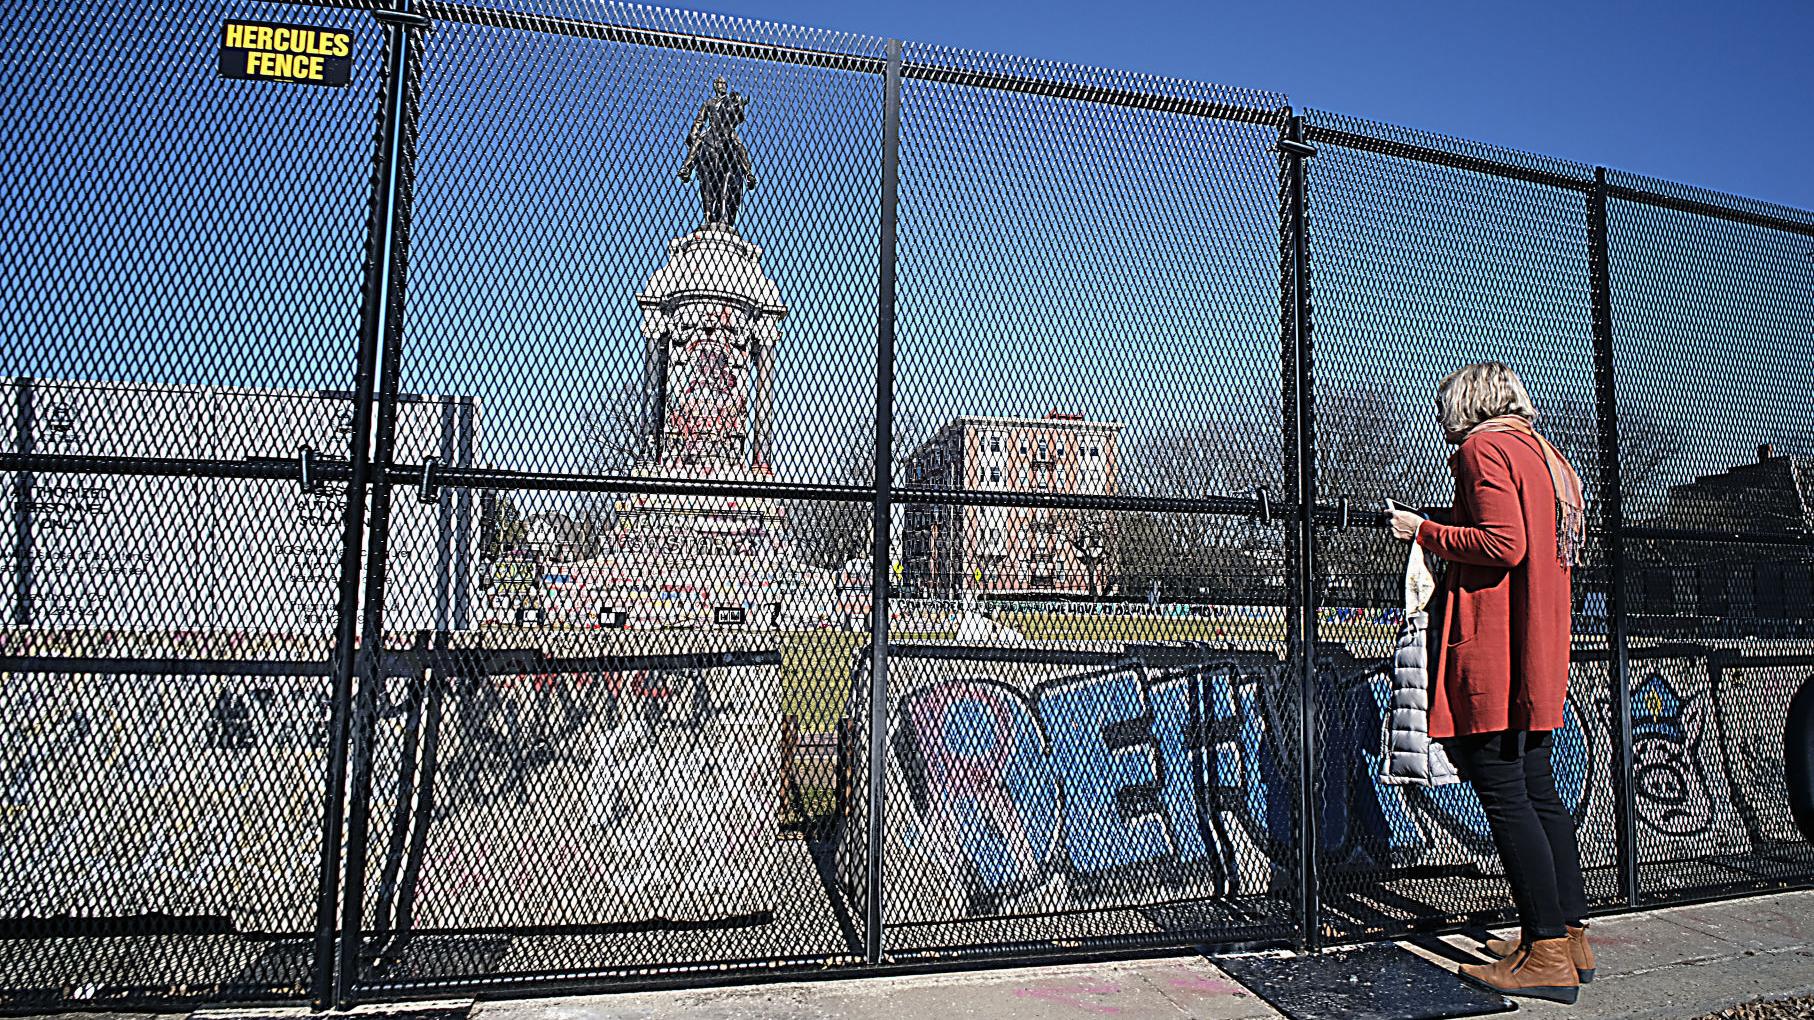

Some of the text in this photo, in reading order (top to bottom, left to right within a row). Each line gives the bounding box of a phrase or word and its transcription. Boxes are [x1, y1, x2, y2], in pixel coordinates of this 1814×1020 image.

[226, 24, 349, 57] HERCULES
[246, 51, 325, 80] FENCE
[10, 486, 111, 499] ATHORIZED
[41, 518, 81, 530] ONLY
